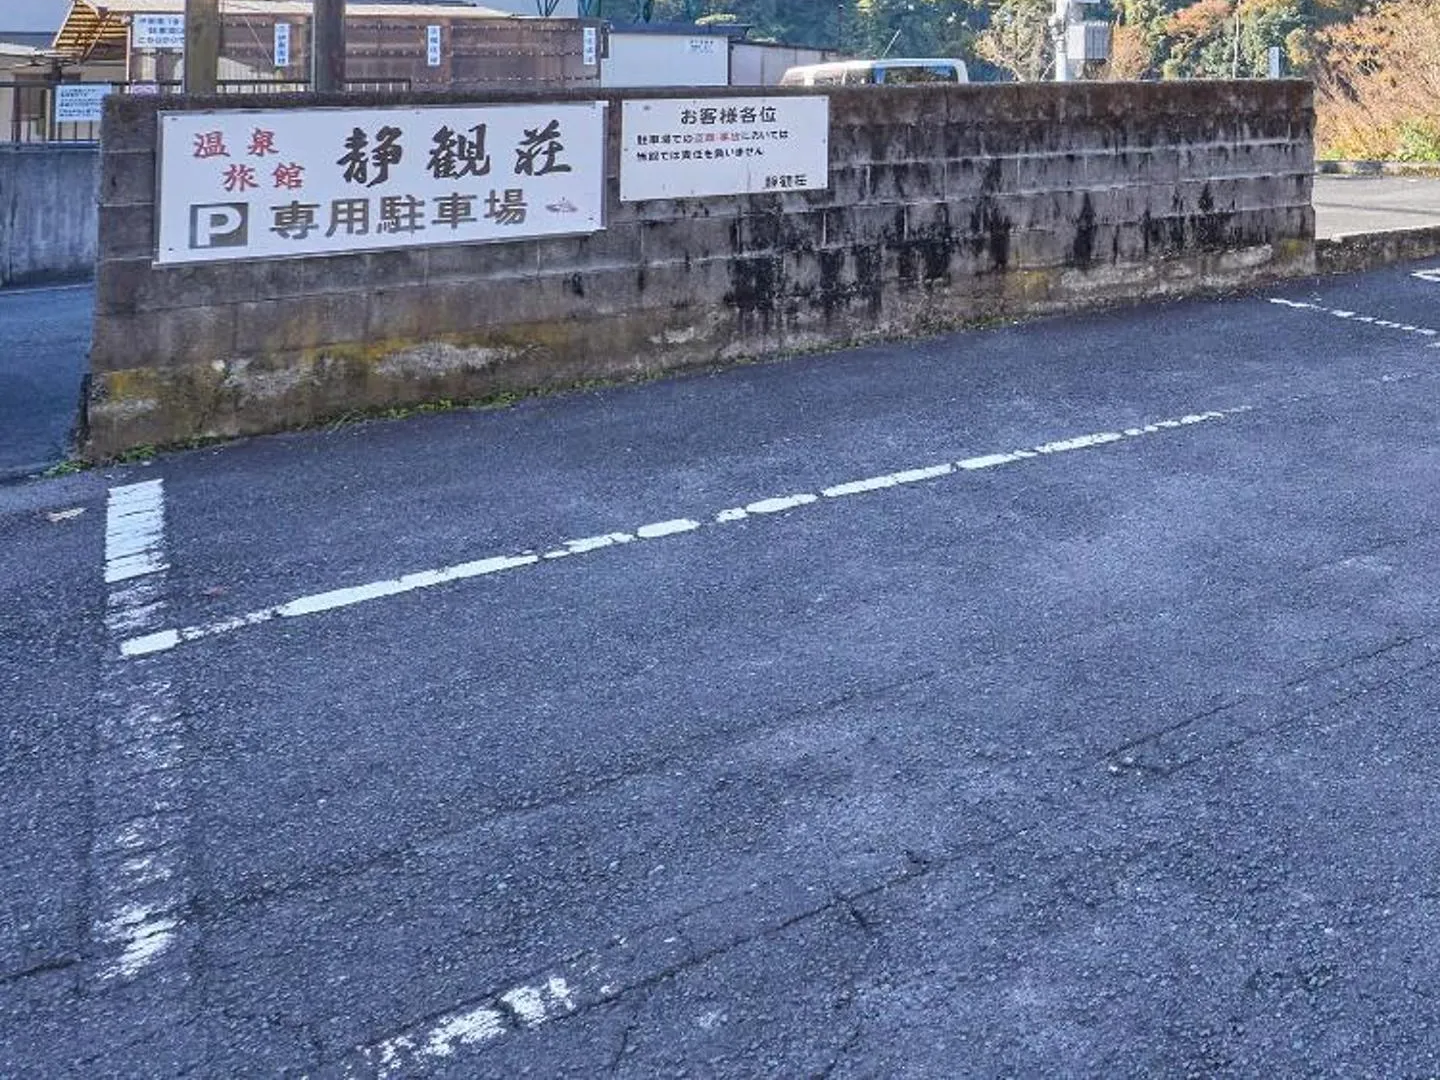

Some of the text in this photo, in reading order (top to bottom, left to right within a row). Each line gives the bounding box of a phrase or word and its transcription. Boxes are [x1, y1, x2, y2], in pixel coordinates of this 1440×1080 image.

[680, 106, 777, 126] お客様各位
[193, 126, 280, 158] 温泉
[336, 119, 573, 188] 静観荘
[222, 161, 305, 192] 旅館
[199, 188, 528, 247] P 専用駐車場
